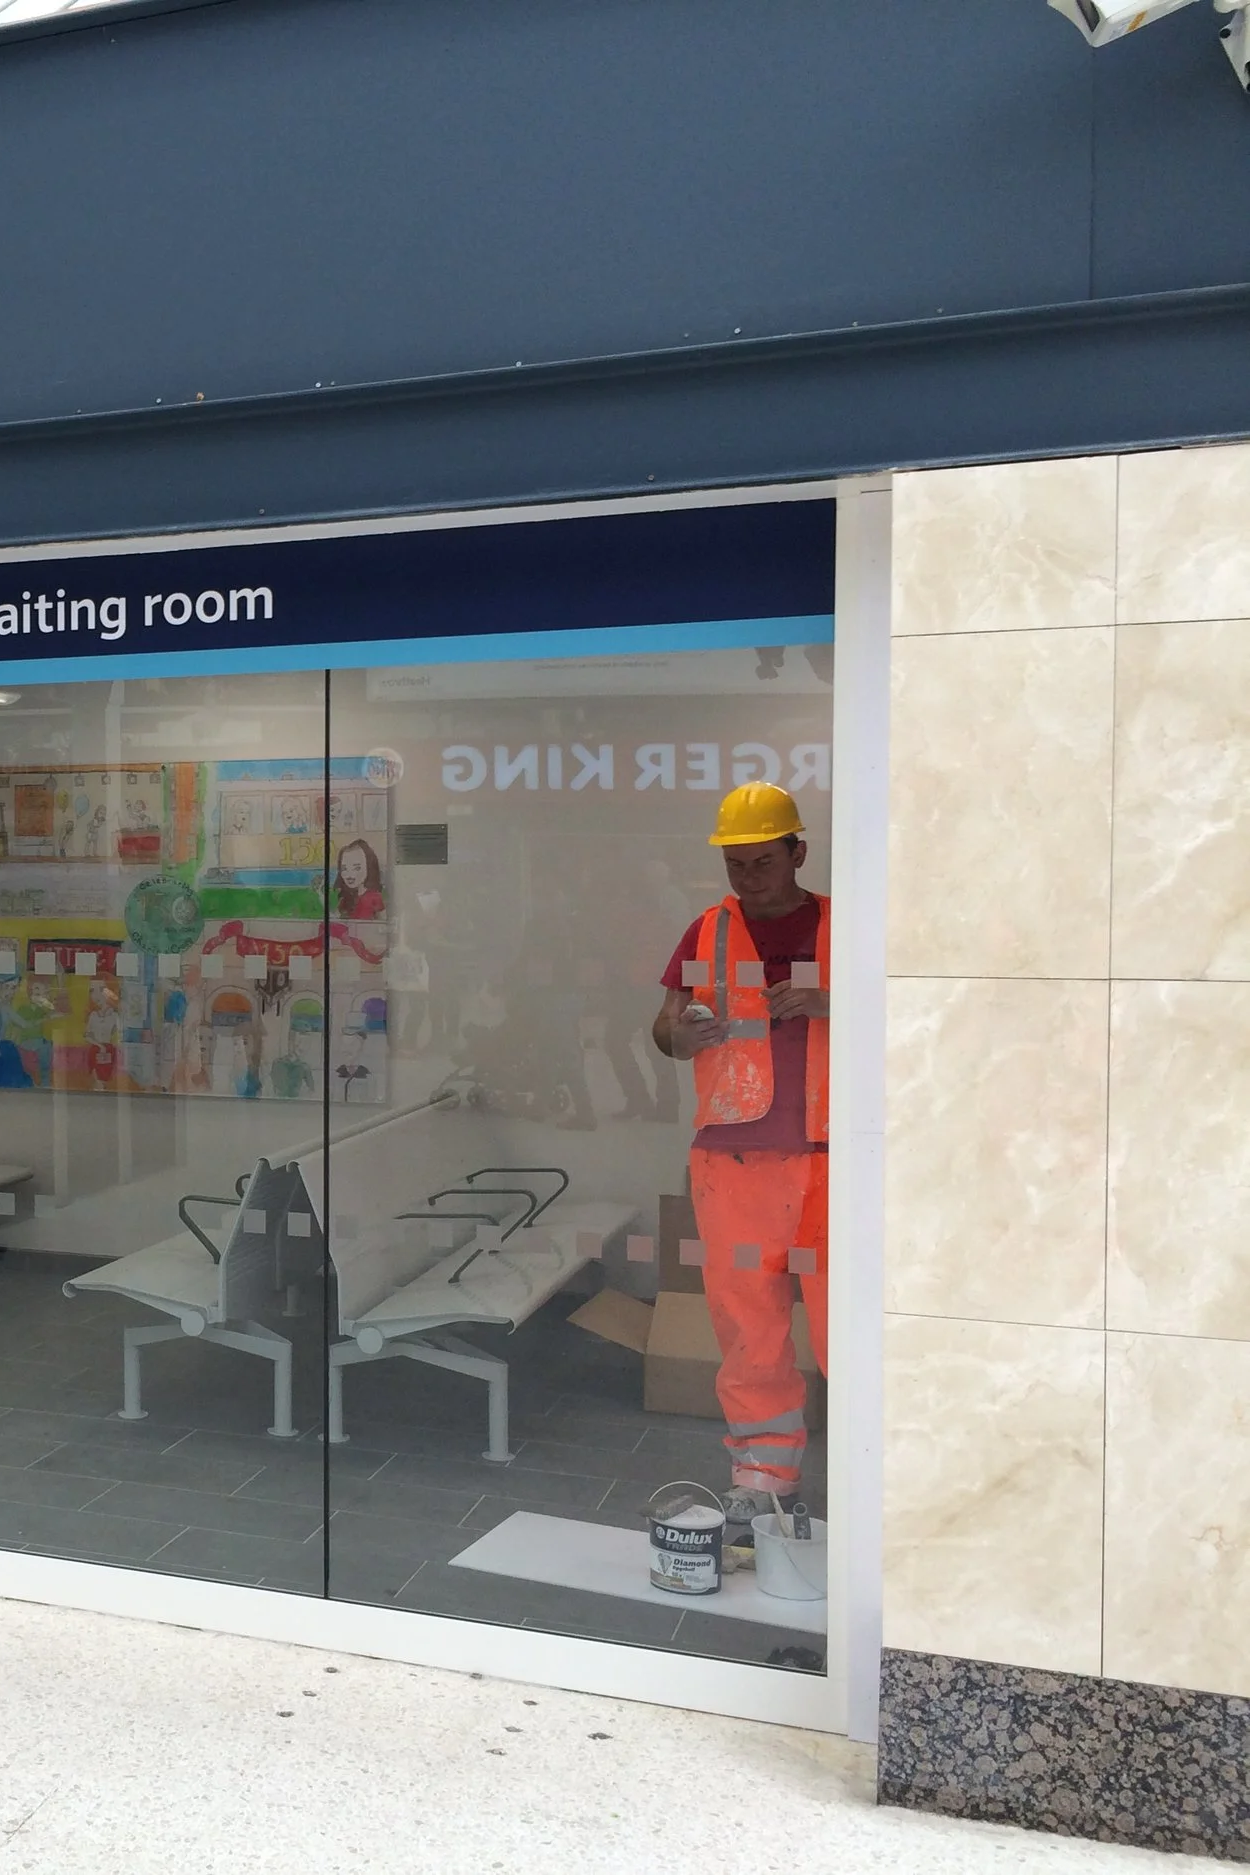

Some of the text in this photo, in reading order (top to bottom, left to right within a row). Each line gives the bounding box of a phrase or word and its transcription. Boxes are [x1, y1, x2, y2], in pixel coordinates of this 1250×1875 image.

[144, 586, 274, 626] room
[279, 836, 335, 866] 150
[666, 1529, 713, 1544] Dulux
[673, 1559, 711, 1567] Diamond
